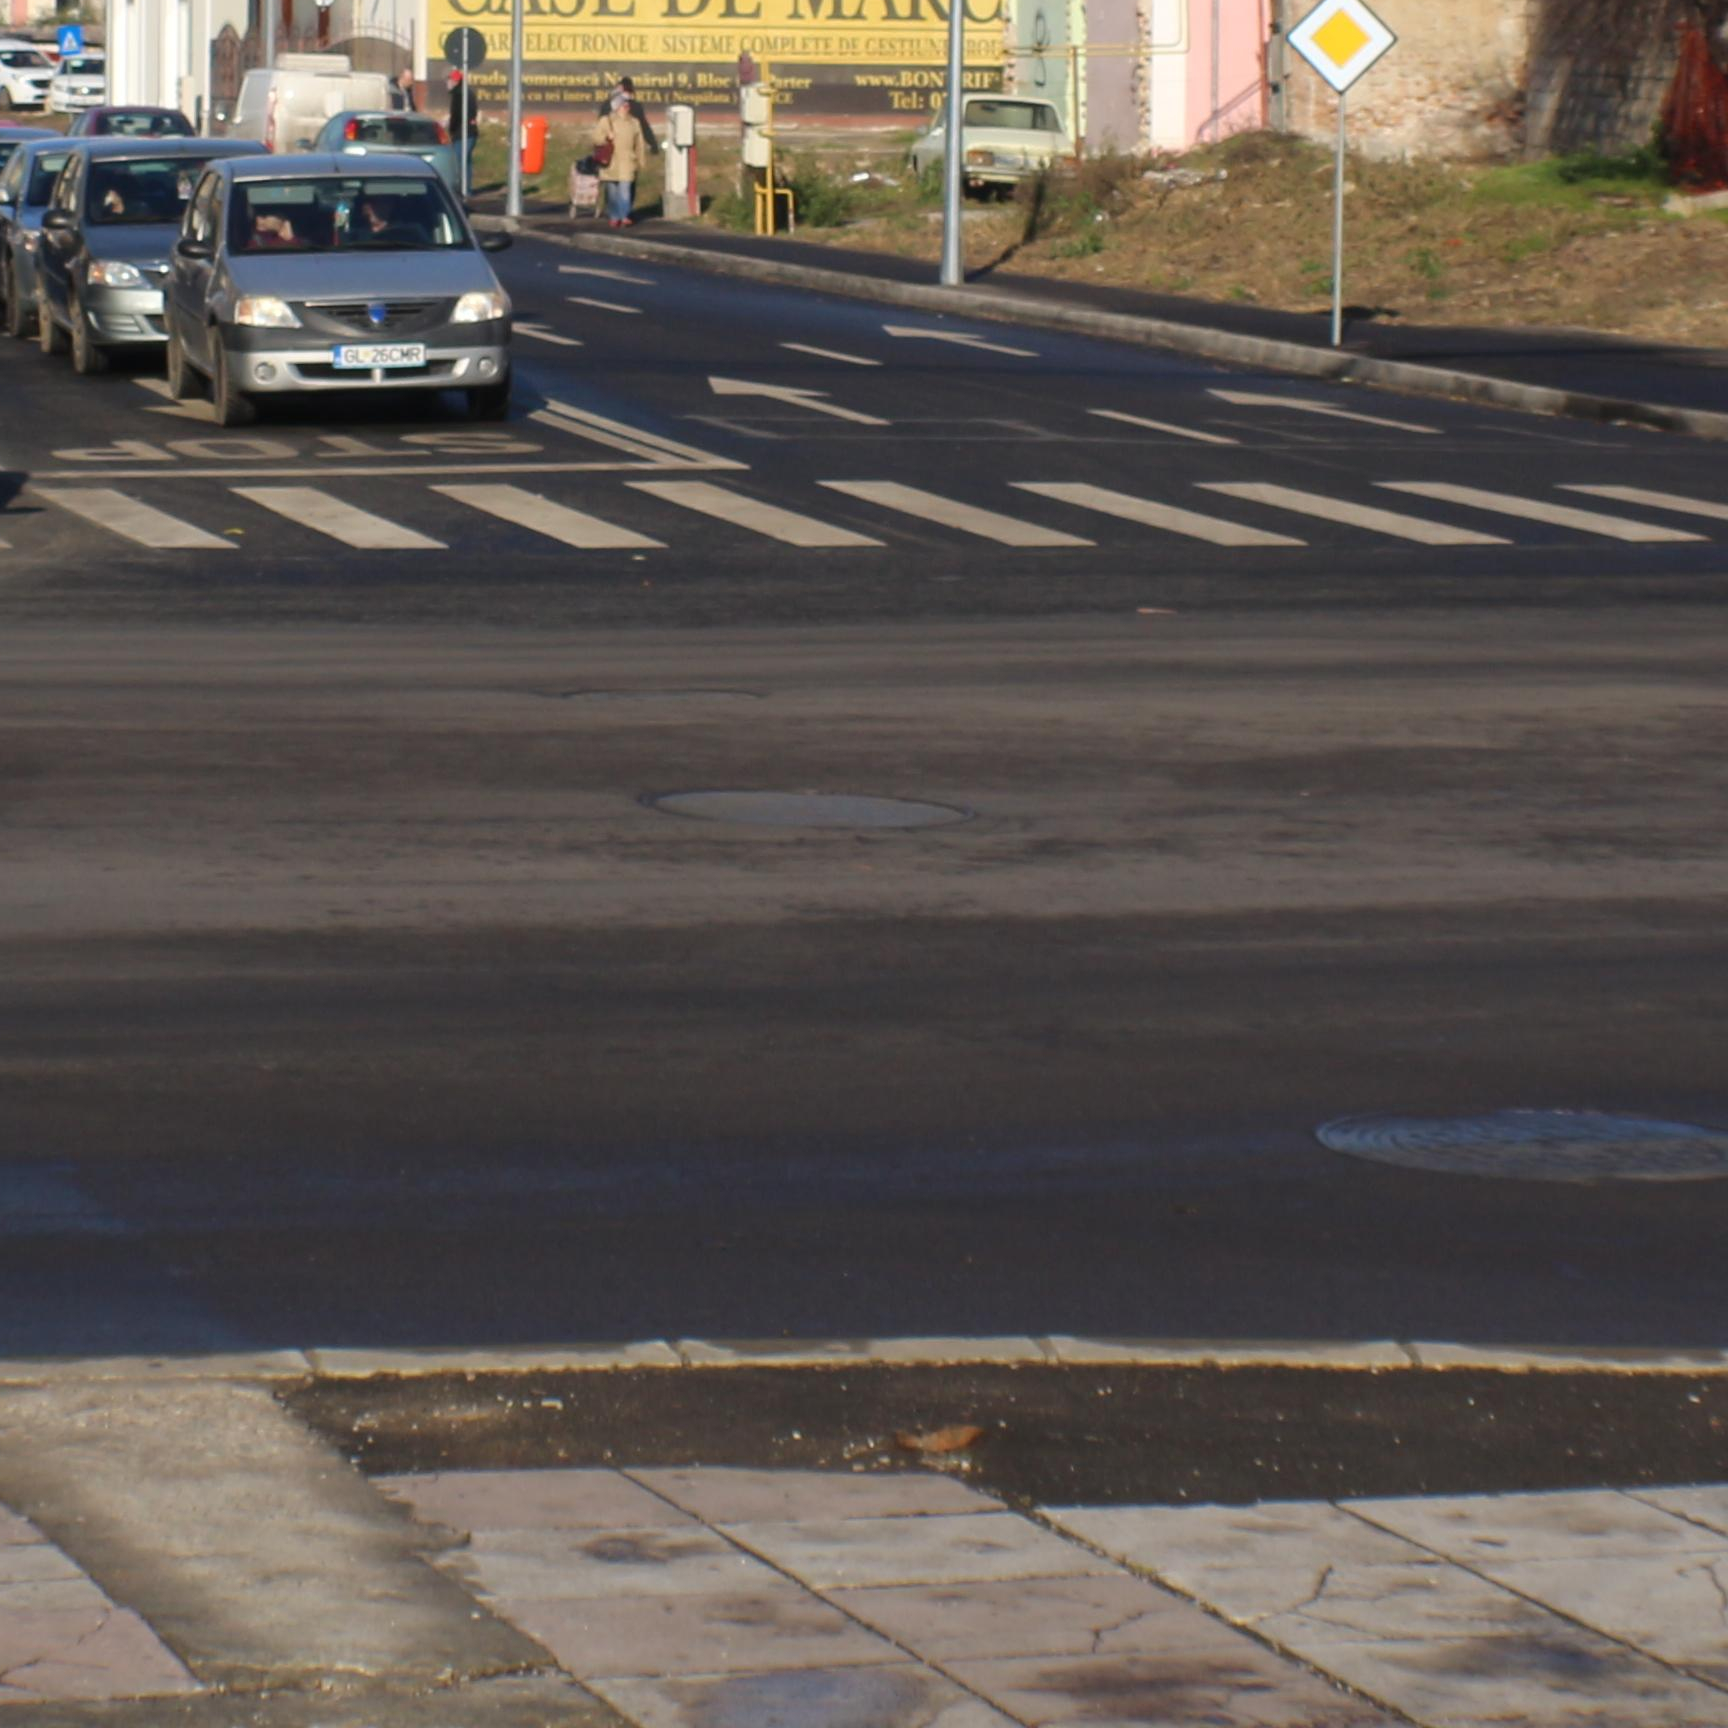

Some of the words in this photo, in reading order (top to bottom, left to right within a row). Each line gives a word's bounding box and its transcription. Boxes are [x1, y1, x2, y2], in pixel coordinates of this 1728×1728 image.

[525, 32, 649, 54] ELECTRONICE
[662, 33, 736, 55] SISTEME
[739, 35, 835, 56] COMPLETE
[838, 37, 859, 57] DE
[465, 70, 508, 86] trada
[696, 72, 731, 87] Bloc
[888, 91, 925, 110] Tel:
[343, 347, 364, 364] GL
